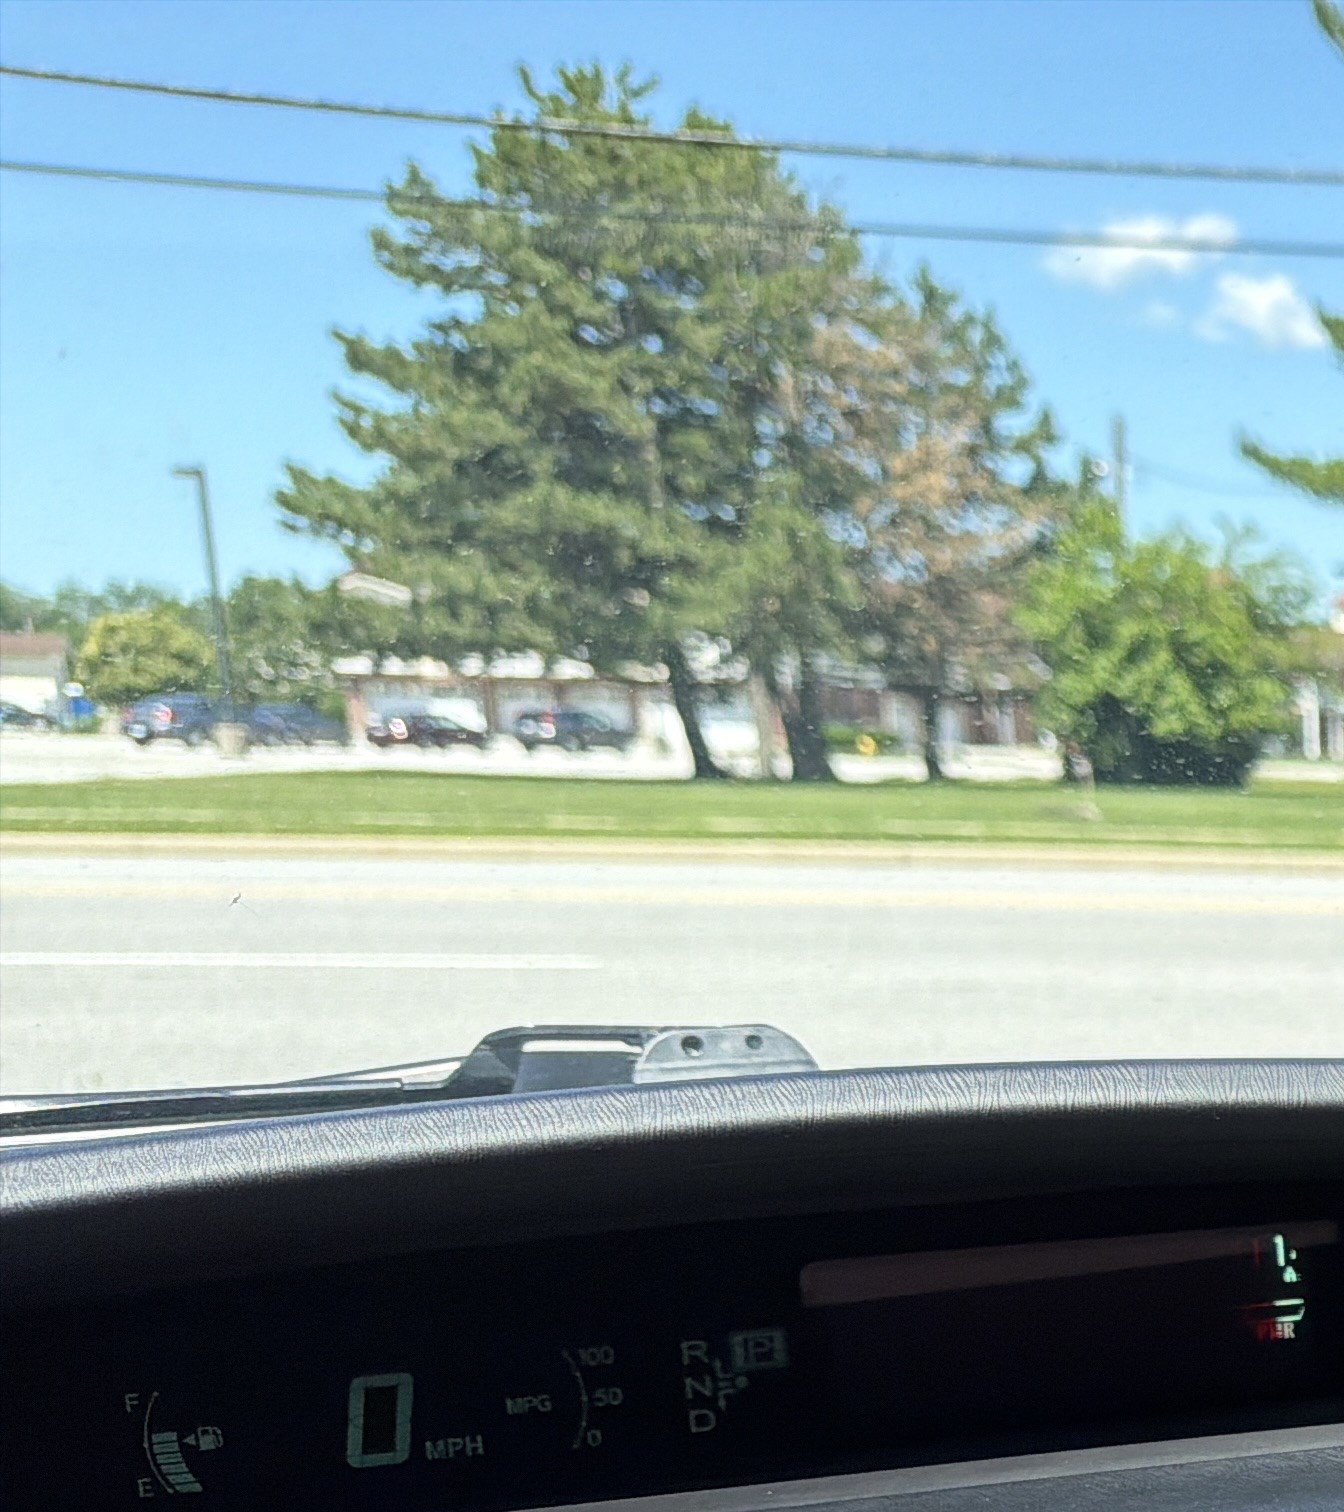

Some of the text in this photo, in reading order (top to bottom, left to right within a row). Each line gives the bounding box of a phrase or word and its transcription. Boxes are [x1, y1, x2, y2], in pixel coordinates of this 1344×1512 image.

[680, 1339, 710, 1366] R
[684, 1375, 714, 1400] N
[124, 1393, 140, 1415] F
[504, 1393, 553, 1416] MPG
[346, 1373, 414, 1468] 0
[688, 1408, 717, 1434] D
[425, 1433, 486, 1461] MPH
[138, 1478, 154, 1499] E
